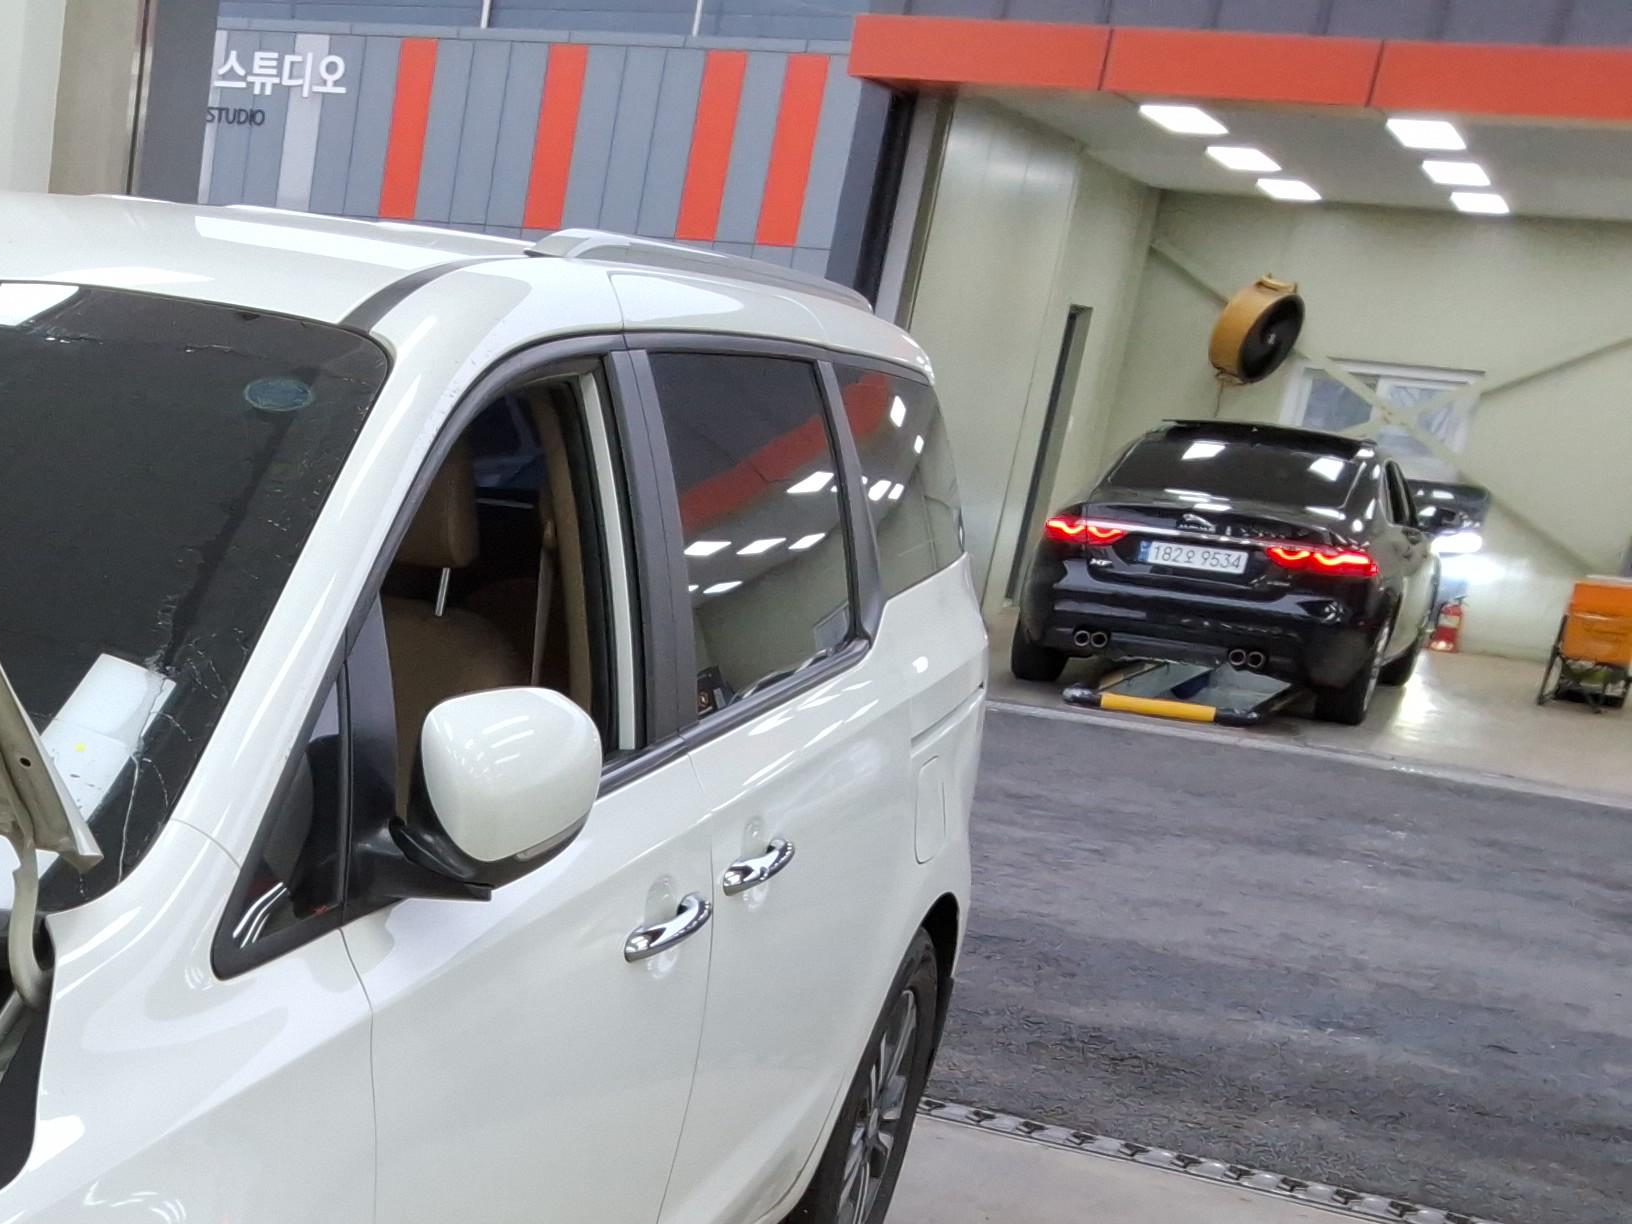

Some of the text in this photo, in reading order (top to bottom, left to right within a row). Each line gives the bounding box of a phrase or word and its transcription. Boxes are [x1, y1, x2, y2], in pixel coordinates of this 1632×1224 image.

[213, 50, 347, 98] 스튜디오
[206, 107, 265, 126] STUDIO
[1201, 550, 1241, 569] 9534
